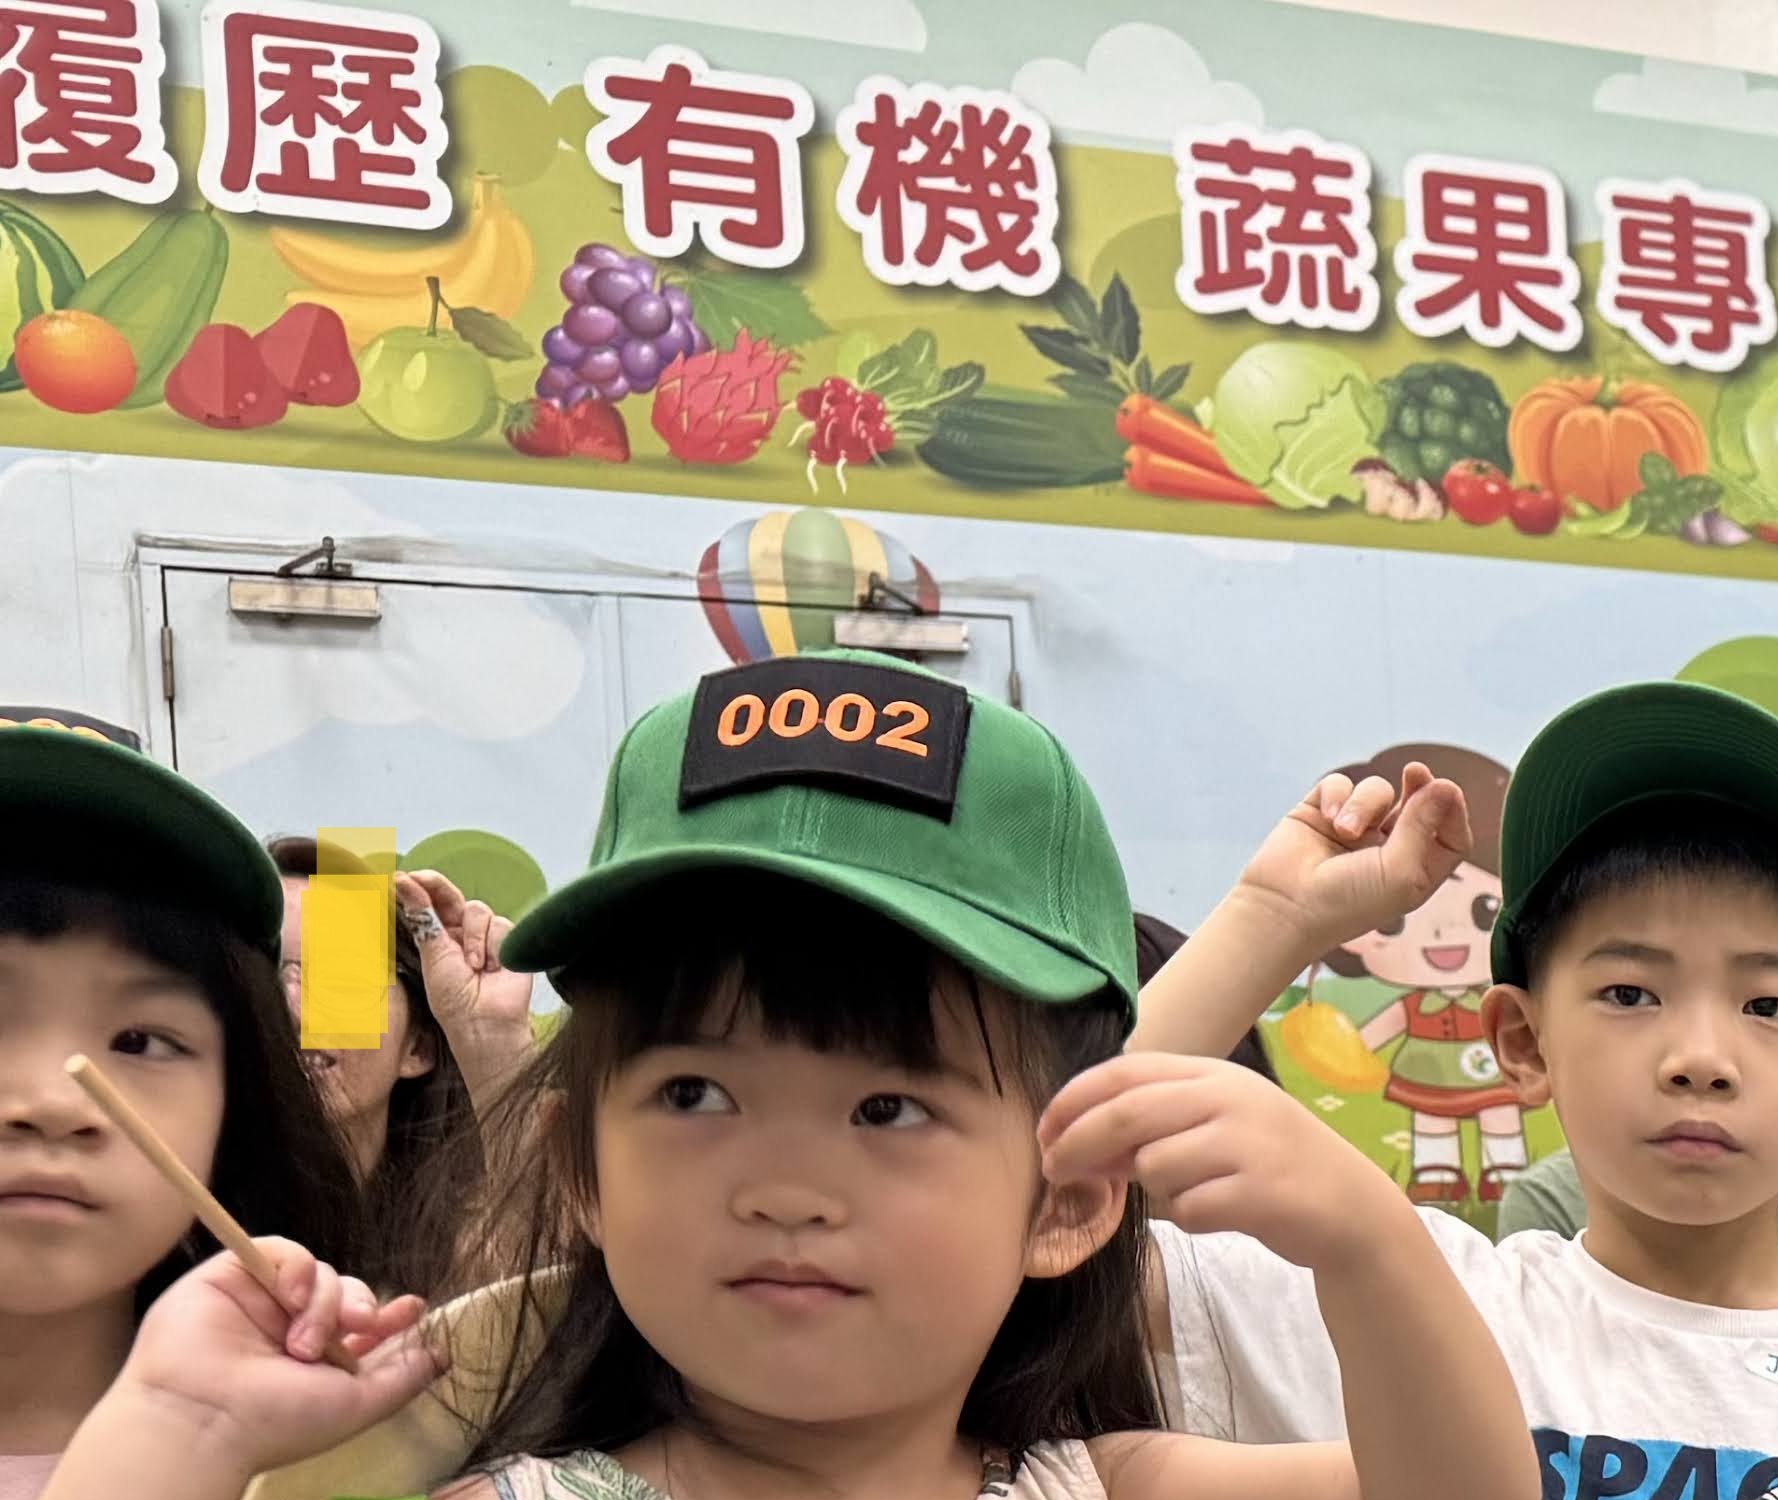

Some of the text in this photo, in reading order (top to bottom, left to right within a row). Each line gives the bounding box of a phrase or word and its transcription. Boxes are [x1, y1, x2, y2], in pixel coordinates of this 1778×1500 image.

[0, 0, 430, 211] 履歷
[604, 63, 1041, 277] 有機
[717, 688, 930, 758] 0002
